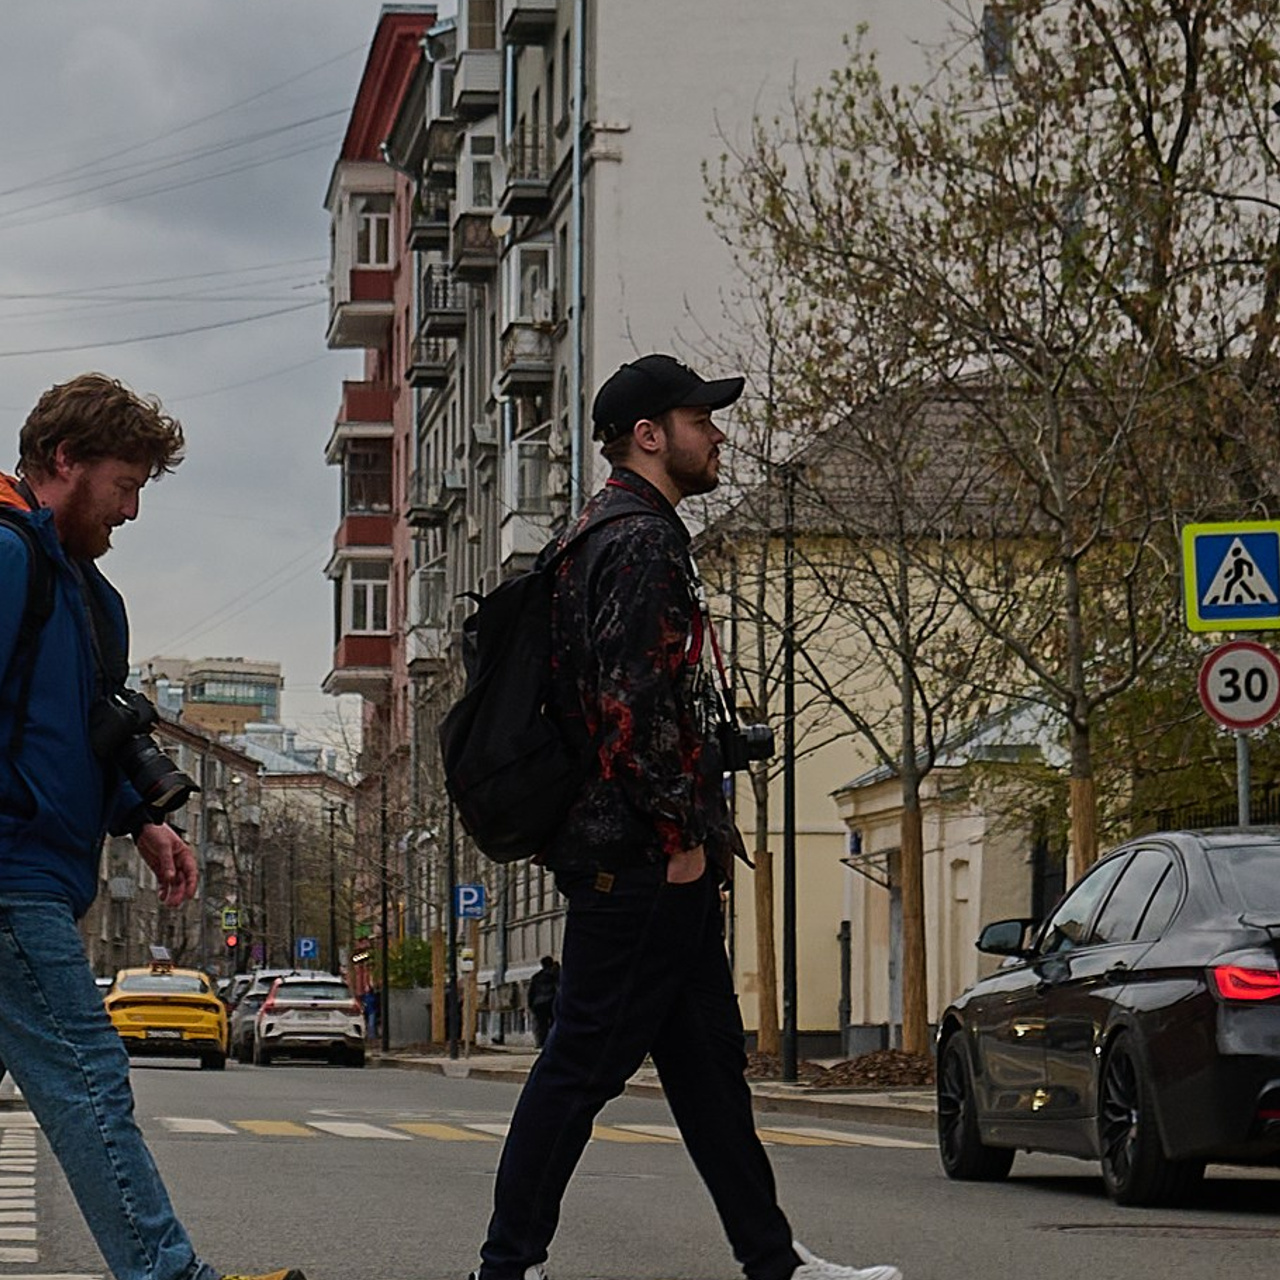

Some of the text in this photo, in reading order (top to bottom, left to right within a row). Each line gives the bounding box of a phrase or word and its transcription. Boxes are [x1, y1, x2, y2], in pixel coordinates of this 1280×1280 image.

[1218, 667, 1268, 703] 30
[459, 887, 478, 914] P
[300, 939, 314, 957] P
